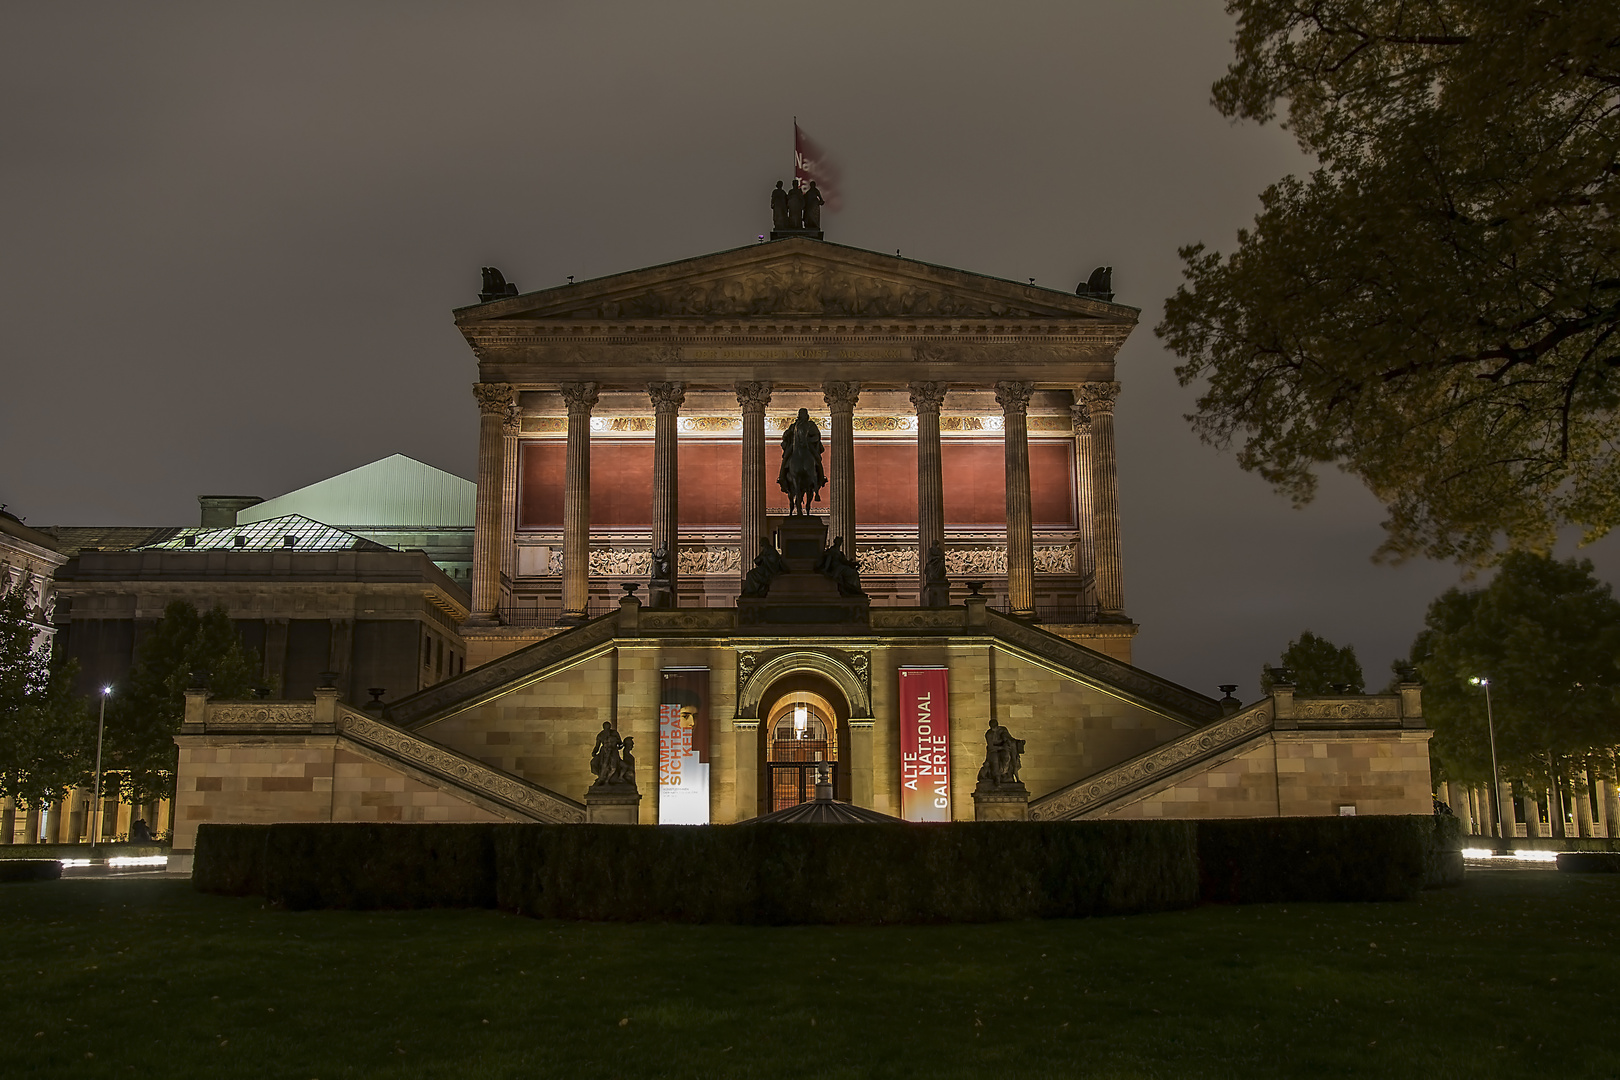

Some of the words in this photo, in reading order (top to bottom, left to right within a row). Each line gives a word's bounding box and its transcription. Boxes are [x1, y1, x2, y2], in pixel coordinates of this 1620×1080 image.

[695, 349, 717, 358] DER
[723, 349, 788, 358] DEUTSCHEN
[793, 349, 830, 358] KUNST
[660, 730, 669, 785] KAMPF
[918, 692, 932, 775] NATIONAL
[904, 752, 917, 790] ALTE
[933, 735, 947, 809] GALERIE
